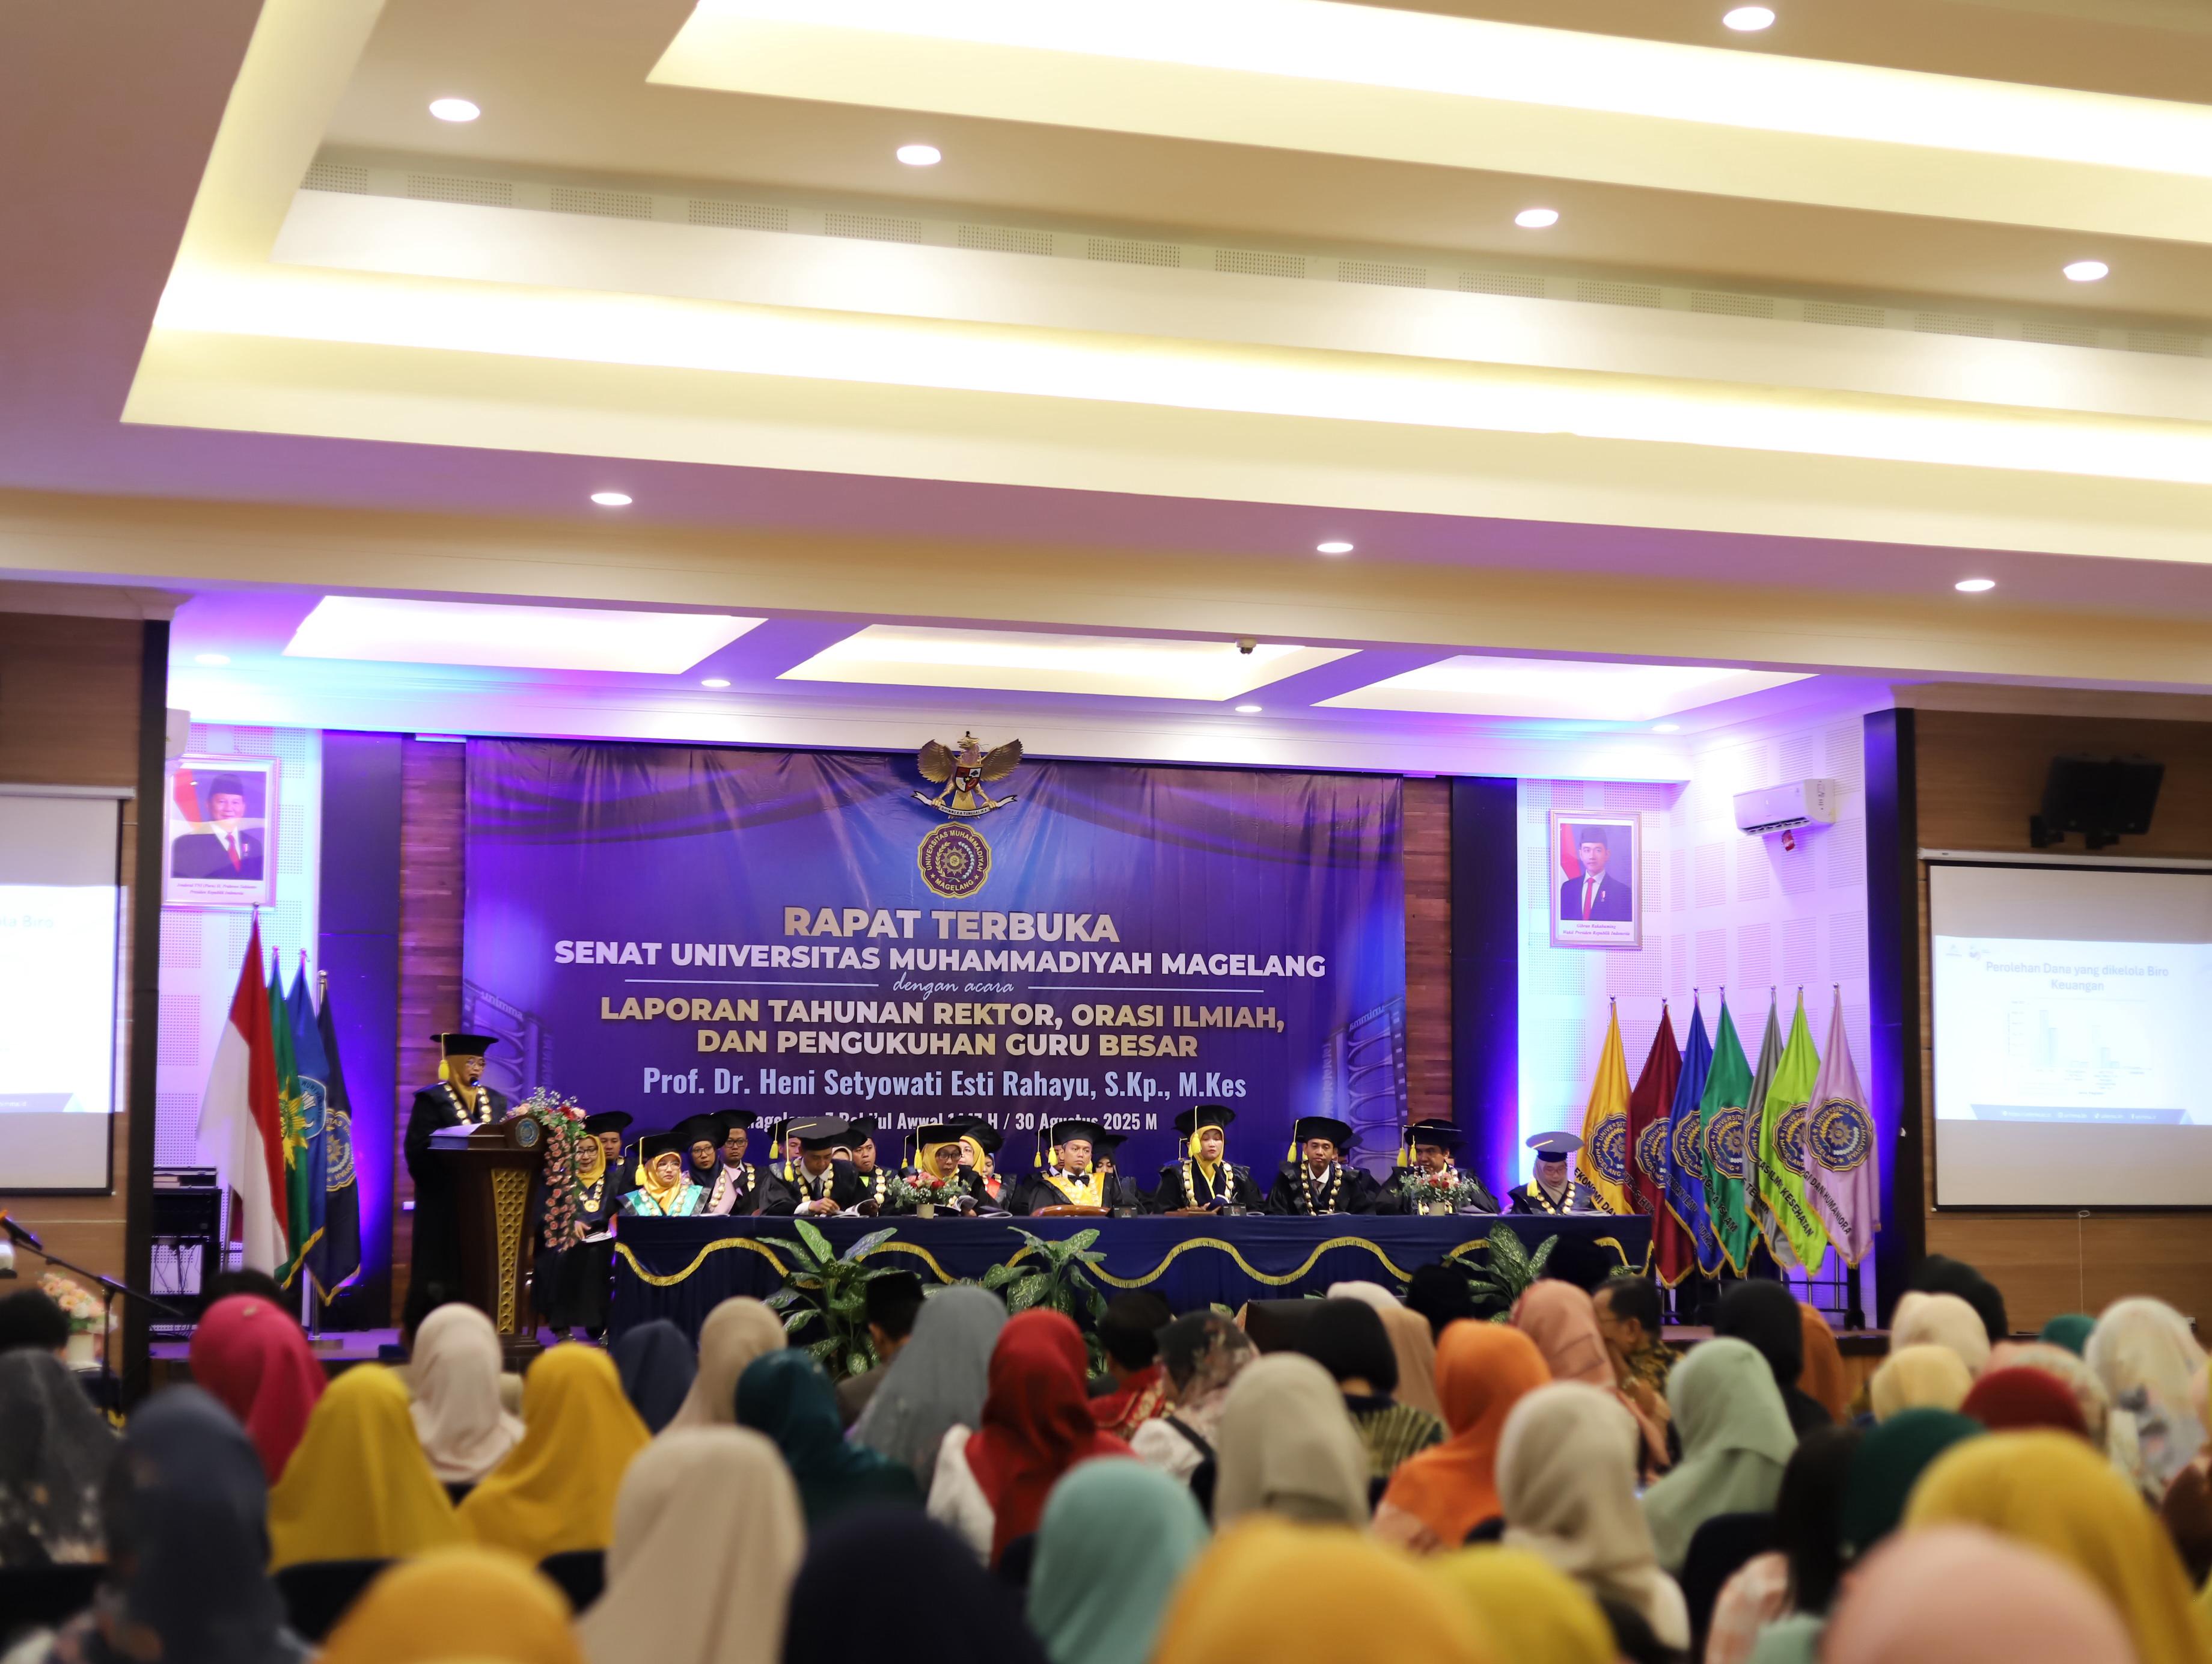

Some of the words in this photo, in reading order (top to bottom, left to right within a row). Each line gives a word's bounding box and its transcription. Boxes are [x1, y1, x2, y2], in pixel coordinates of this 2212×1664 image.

[925, 831, 948, 870] UNIVERSITAS
[950, 830, 984, 872] MUHAMMADIYAH
[935, 878, 974, 891] MAGELANG
[785, 907, 921, 938] RAPAT
[932, 911, 1120, 942] TERBUKA
[555, 941, 662, 964] SENAT
[671, 943, 880, 969] UNIVERSITAS
[890, 948, 1151, 974] MUHAMMADIYAH
[1162, 953, 1325, 977] MAGELANG
[1986, 961, 2041, 974] Perolehan
[2043, 963, 2071, 974] Dana
[2074, 965, 2099, 977] yang
[2102, 964, 2145, 976] dikelola
[2148, 965, 2169, 977] Biro
[893, 971, 958, 1000] dengan
[965, 983, 1014, 993] acara
[2051, 979, 2104, 993] Keuangan
[602, 997, 758, 1021] LAPORAN
[769, 999, 923, 1024] TAHUNAN
[934, 1003, 1062, 1030] REKTOR,
[1072, 1004, 1163, 1026] ORASI
[1174, 1006, 1284, 1033] ILMIAH,
[698, 1030, 766, 1052] DAN
[778, 1031, 995, 1055] PENGUKUHAN
[1006, 1033, 1089, 1056] GURU
[1100, 1035, 1197, 1056] BESAR
[644, 1068, 704, 1094] Prof.
[715, 1068, 750, 1094] Dr.
[760, 1069, 814, 1094] Heni
[825, 1069, 941, 1100] Setyowati
[952, 1071, 993, 1095] Esti
[1003, 1071, 1096, 1101] Rahayu,
[1105, 1072, 1170, 1101] S.Kp.,
[1179, 1072, 1246, 1097] M.Kes
[988, 1113, 997, 1130] H
[1015, 1113, 1034, 1130] 30
[1104, 1113, 1140, 1130] 2025
[1146, 1113, 1157, 1130] M
[1598, 1121, 1626, 1141] UNIVERSIT
[1712, 1115, 1743, 1133] UNIVERSITA
[1782, 1111, 1806, 1131] UNIVERSI
[1596, 1148, 1621, 1176] MAGELANG
[1780, 1188, 1814, 1237] KESEHATAN
[1810, 1178, 1826, 1195] DAN
[1823, 1191, 1852, 1235] HUMANIORA
